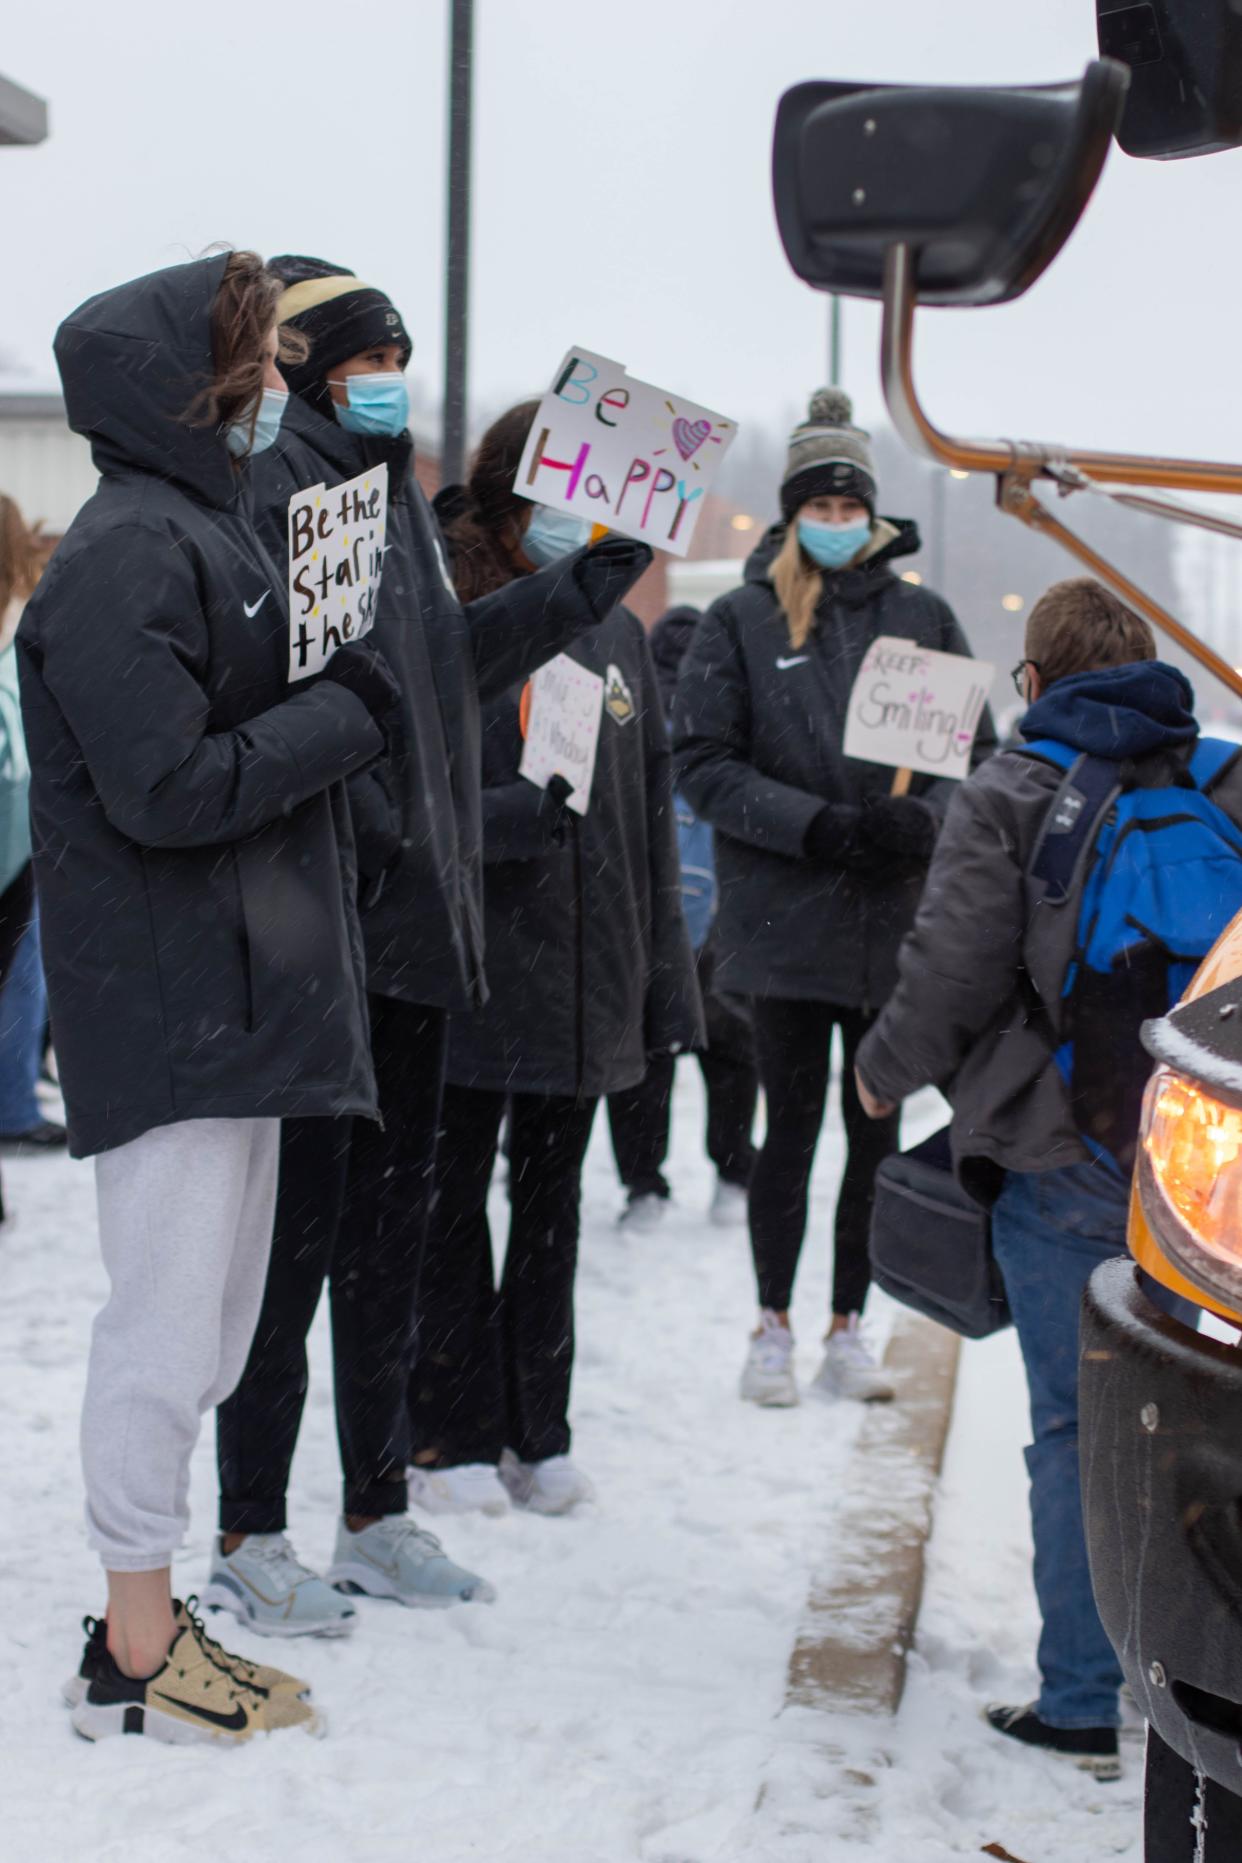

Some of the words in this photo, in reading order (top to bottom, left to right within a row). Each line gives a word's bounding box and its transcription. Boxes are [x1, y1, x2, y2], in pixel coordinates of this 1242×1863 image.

[553, 356, 630, 428] Be
[291, 504, 334, 562] Be
[336, 487, 381, 526] the
[292, 612, 355, 668] the
[873, 650, 924, 676] KEEP
